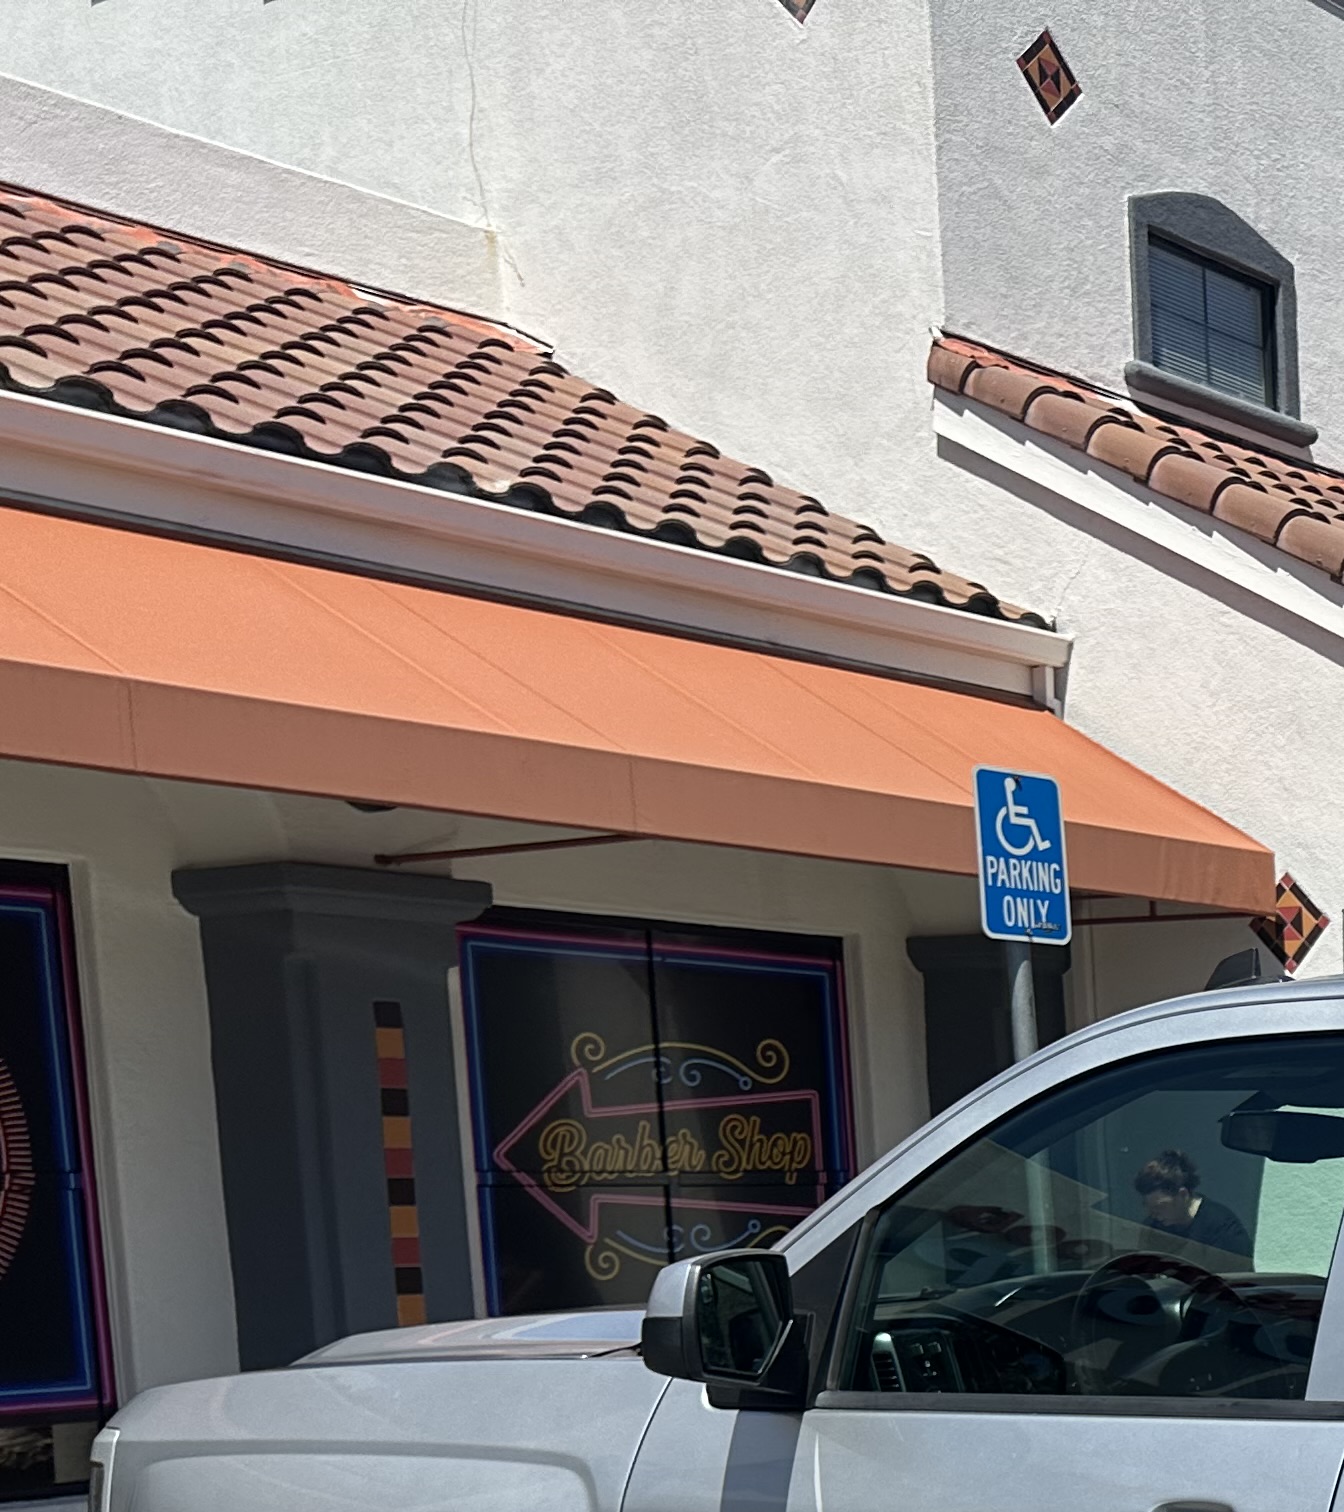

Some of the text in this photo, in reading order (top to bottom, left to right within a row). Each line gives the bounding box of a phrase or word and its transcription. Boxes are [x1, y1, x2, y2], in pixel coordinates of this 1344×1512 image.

[985, 855, 1062, 895] PARKING
[1003, 895, 1050, 929] ONLY
[538, 1113, 812, 1192] Barber Shop
